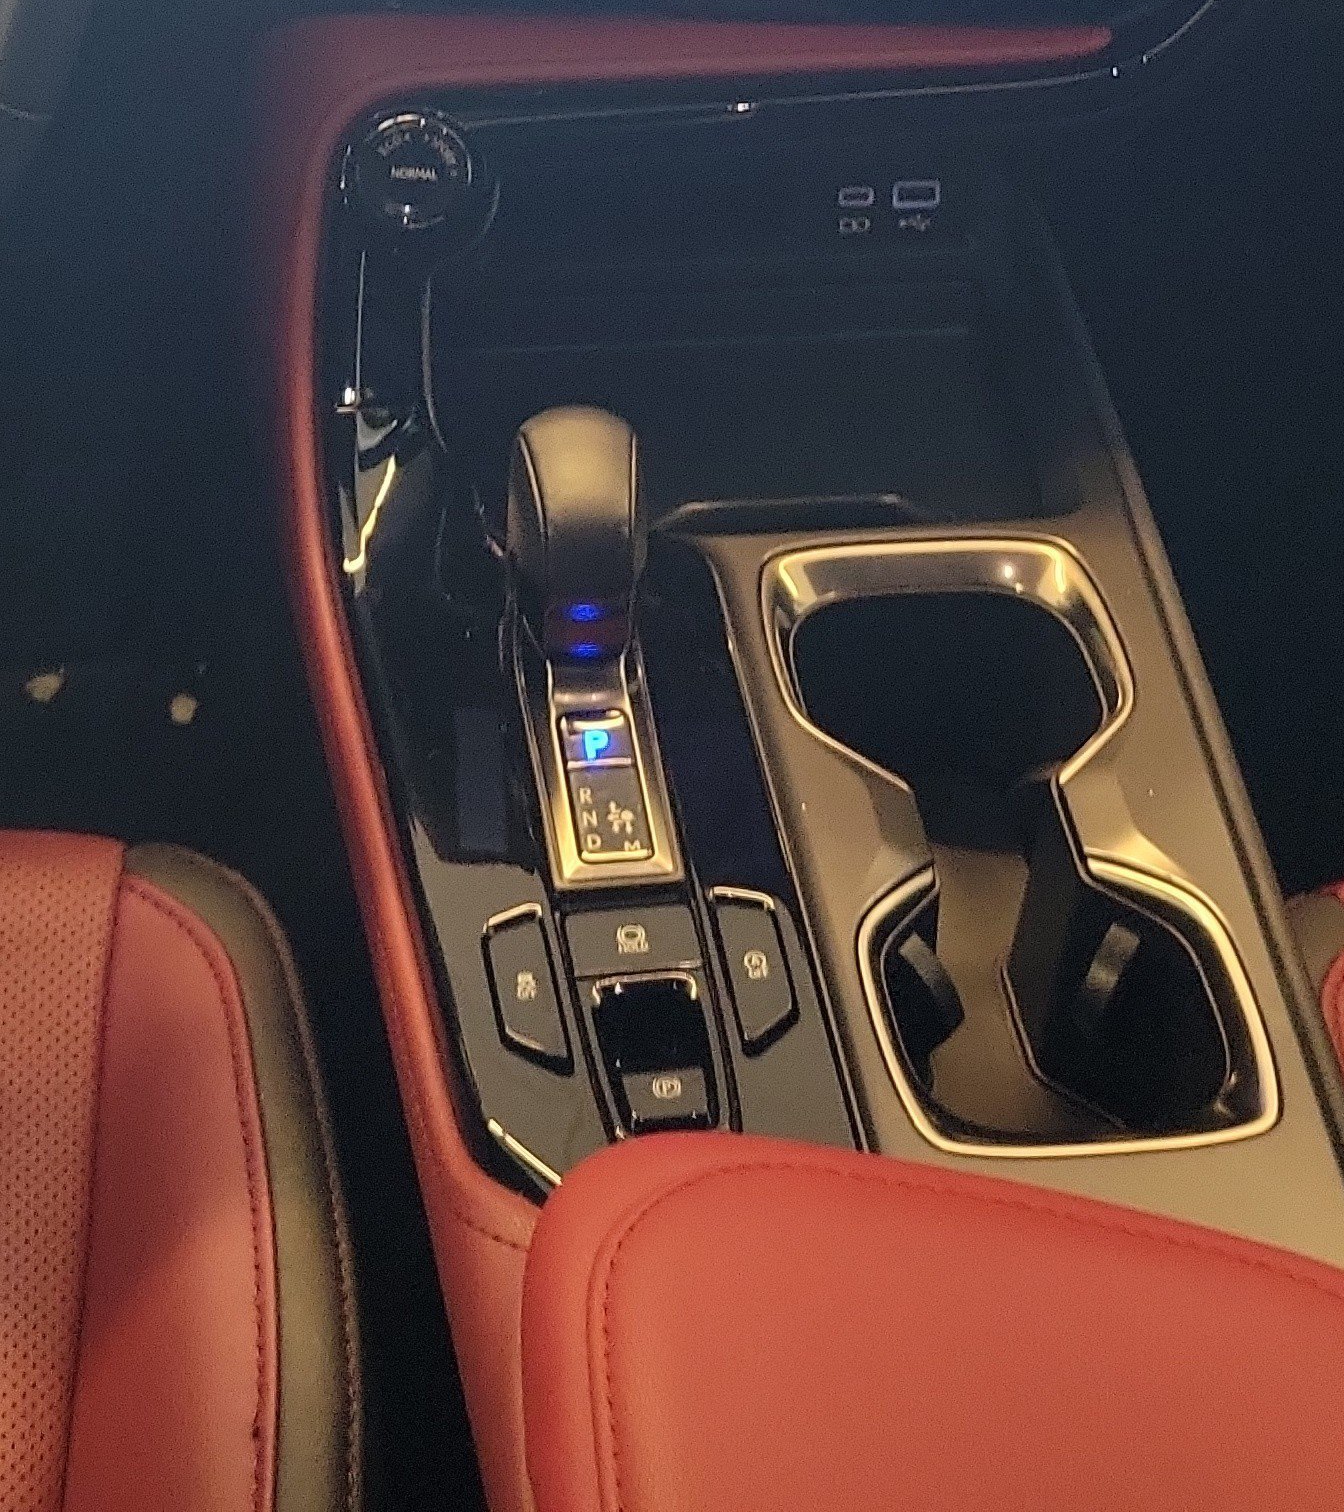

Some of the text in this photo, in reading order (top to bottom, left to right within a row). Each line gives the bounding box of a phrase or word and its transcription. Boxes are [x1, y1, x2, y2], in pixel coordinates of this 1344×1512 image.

[583, 729, 610, 760] P
[579, 787, 593, 805] R
[582, 811, 598, 826] N
[586, 835, 602, 851] D
[623, 839, 641, 852] M
